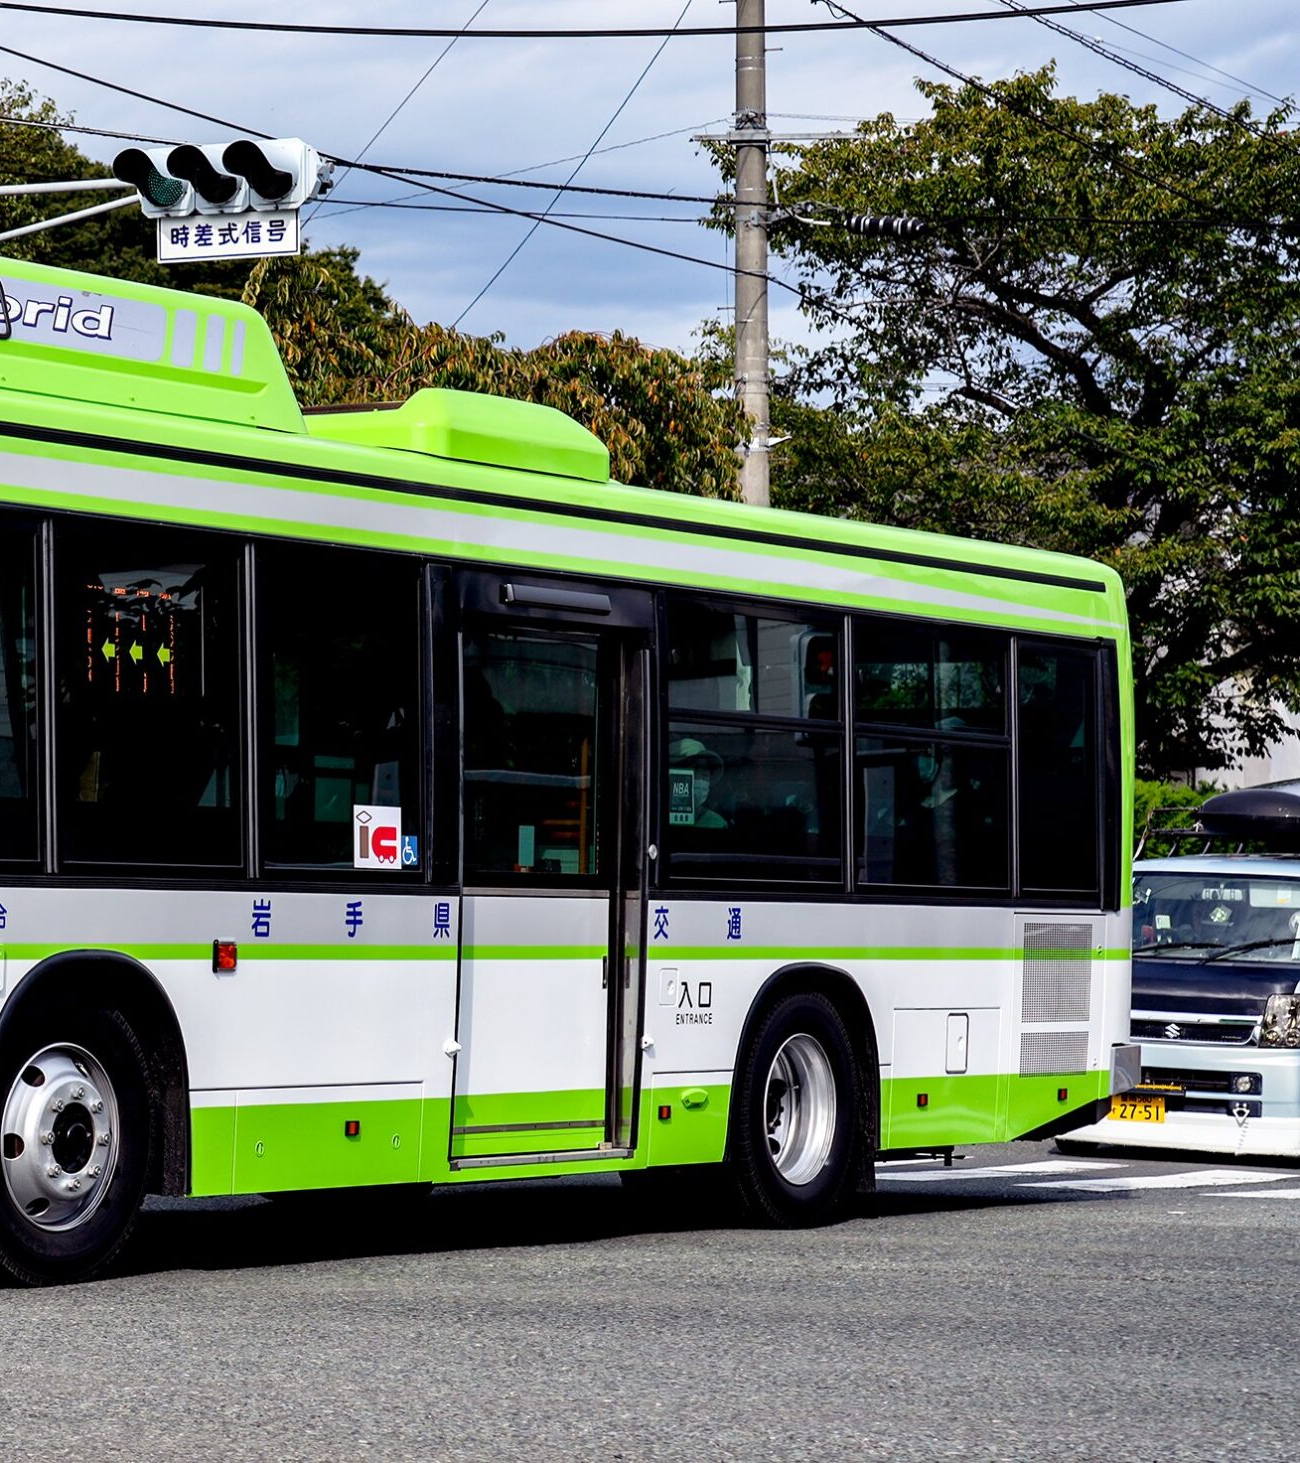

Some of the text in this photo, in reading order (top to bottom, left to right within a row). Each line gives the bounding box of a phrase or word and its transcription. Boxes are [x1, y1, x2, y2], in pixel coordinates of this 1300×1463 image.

[170, 219, 287, 249] 時差式信号
[678, 982, 712, 1008] 入口
[676, 1013, 713, 1025] ENTRANCE
[1120, 1103, 1159, 1120] 27-51
